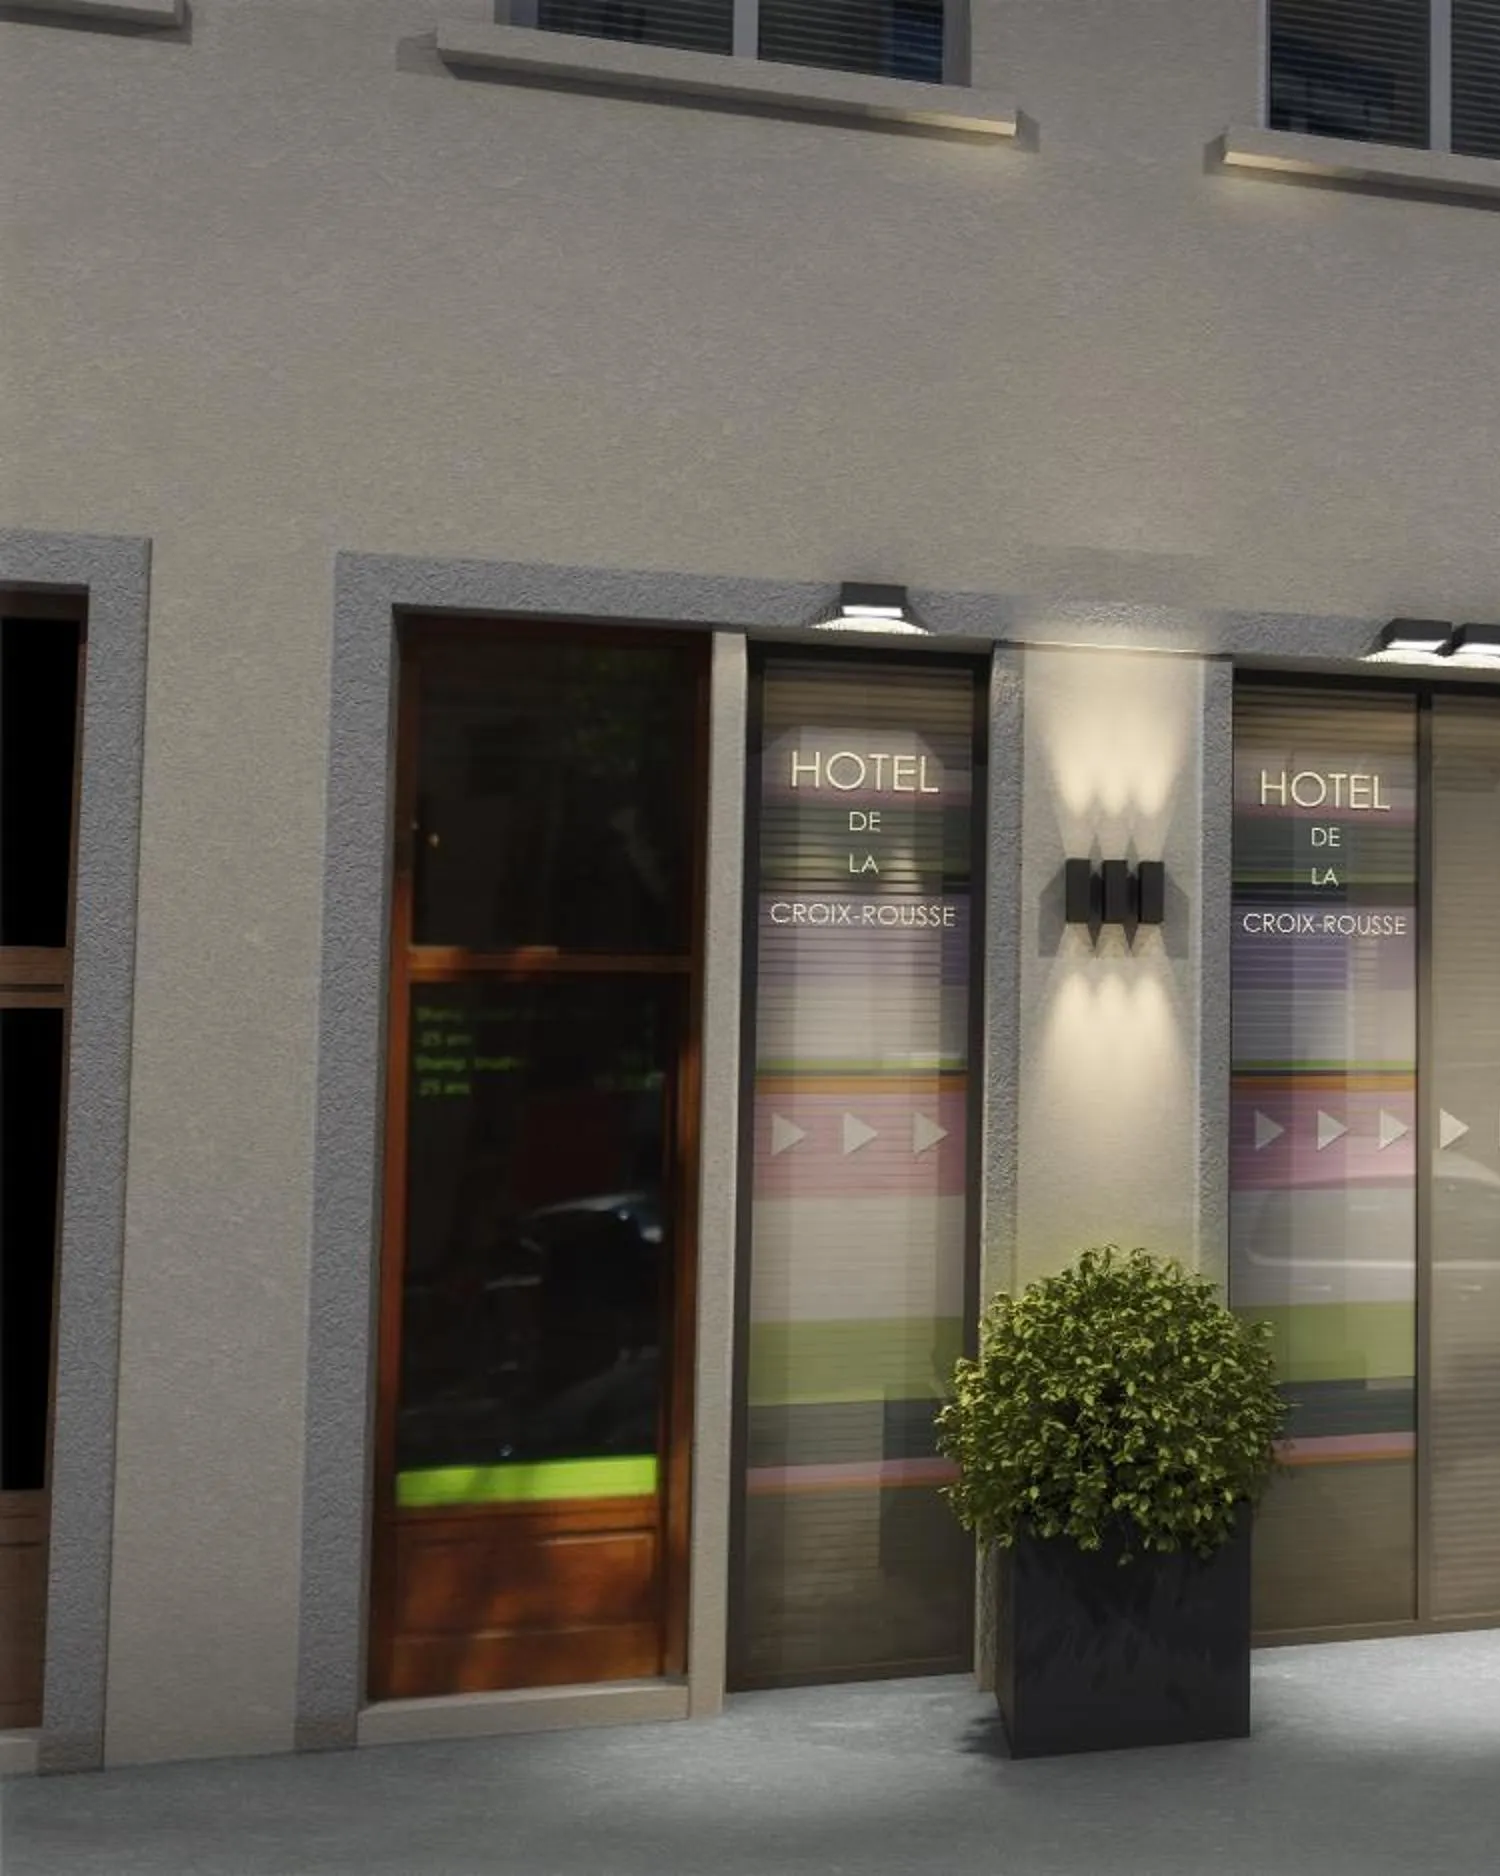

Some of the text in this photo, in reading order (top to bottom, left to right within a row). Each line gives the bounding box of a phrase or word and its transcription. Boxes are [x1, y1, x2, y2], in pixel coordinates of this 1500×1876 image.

[790, 751, 939, 793] HOTEL
[1260, 770, 1391, 810] HOTEL
[848, 811, 881, 832] DE
[1311, 827, 1341, 847] DE
[849, 854, 879, 873] LA
[1311, 867, 1340, 886] LA
[769, 902, 957, 927] CROIX-ROUSSE
[1242, 912, 1407, 935] CROIX-ROUSSE
